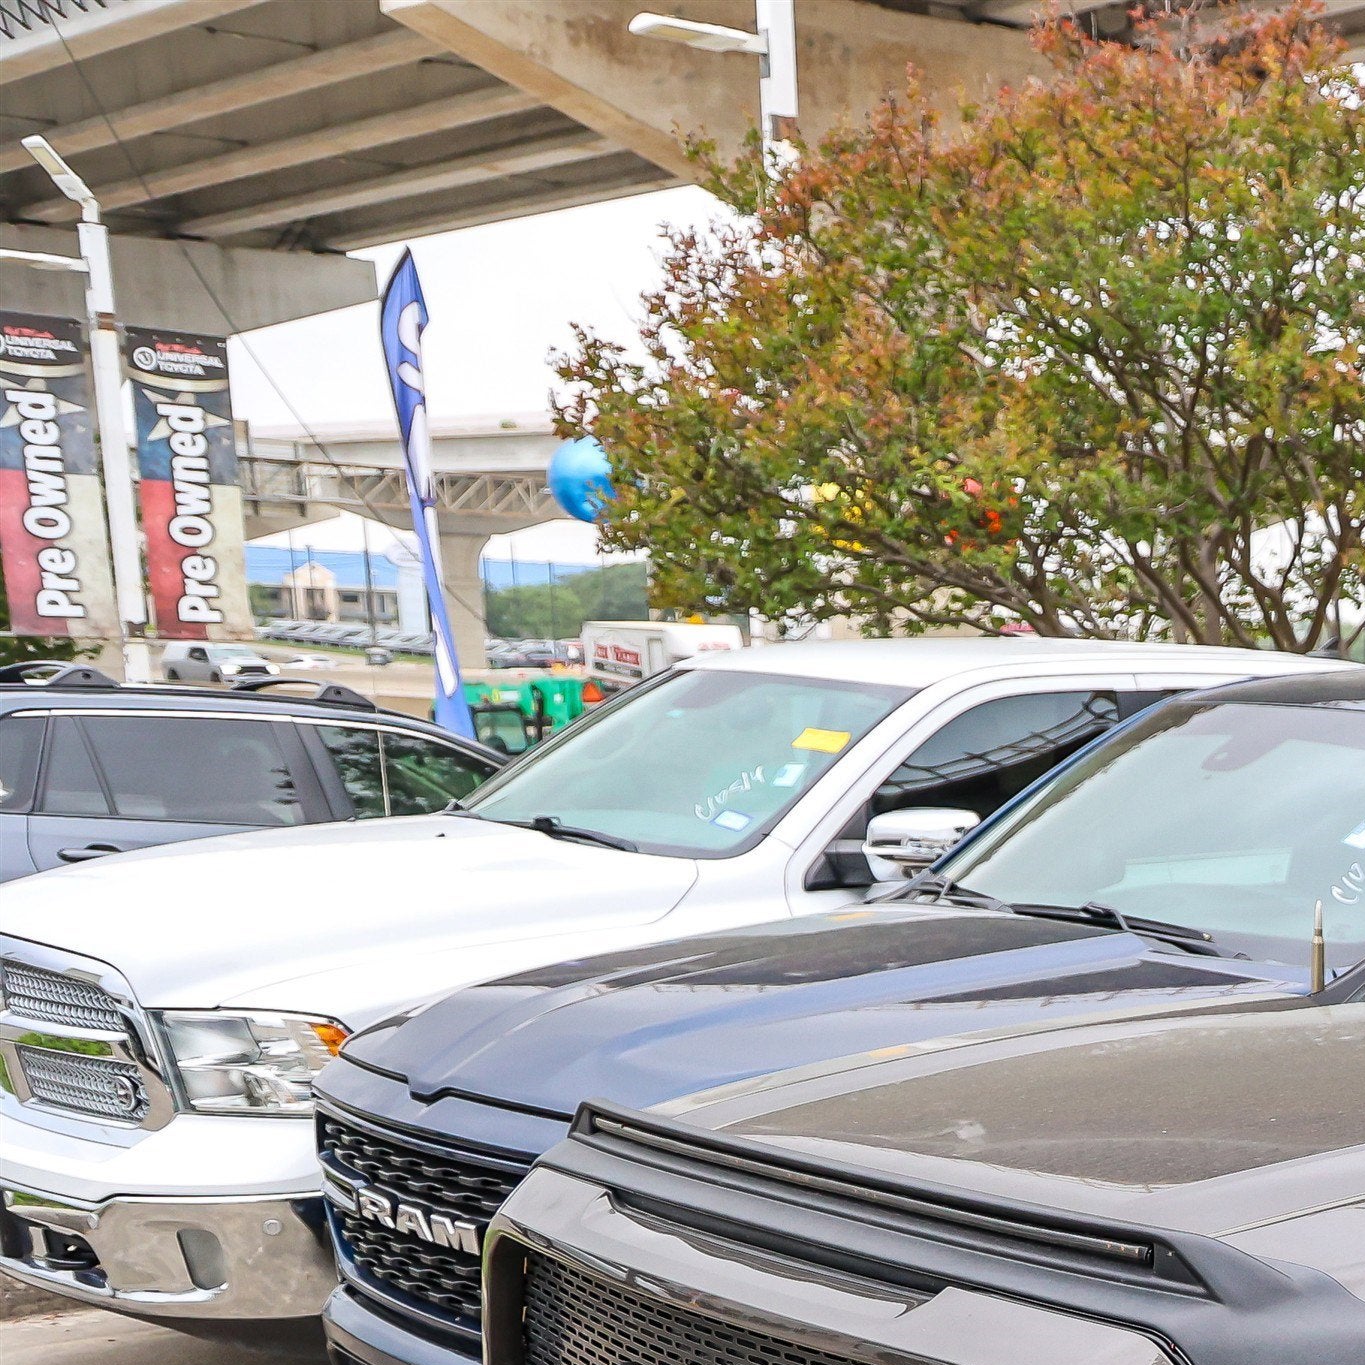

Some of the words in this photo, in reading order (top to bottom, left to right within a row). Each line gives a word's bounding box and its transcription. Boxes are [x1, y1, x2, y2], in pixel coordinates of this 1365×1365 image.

[4, 389, 71, 540] Owned
[156, 402, 216, 548] Owned
[35, 547, 87, 618] Pre
[177, 554, 223, 623] Pre
[358, 1188, 481, 1256] RAM
